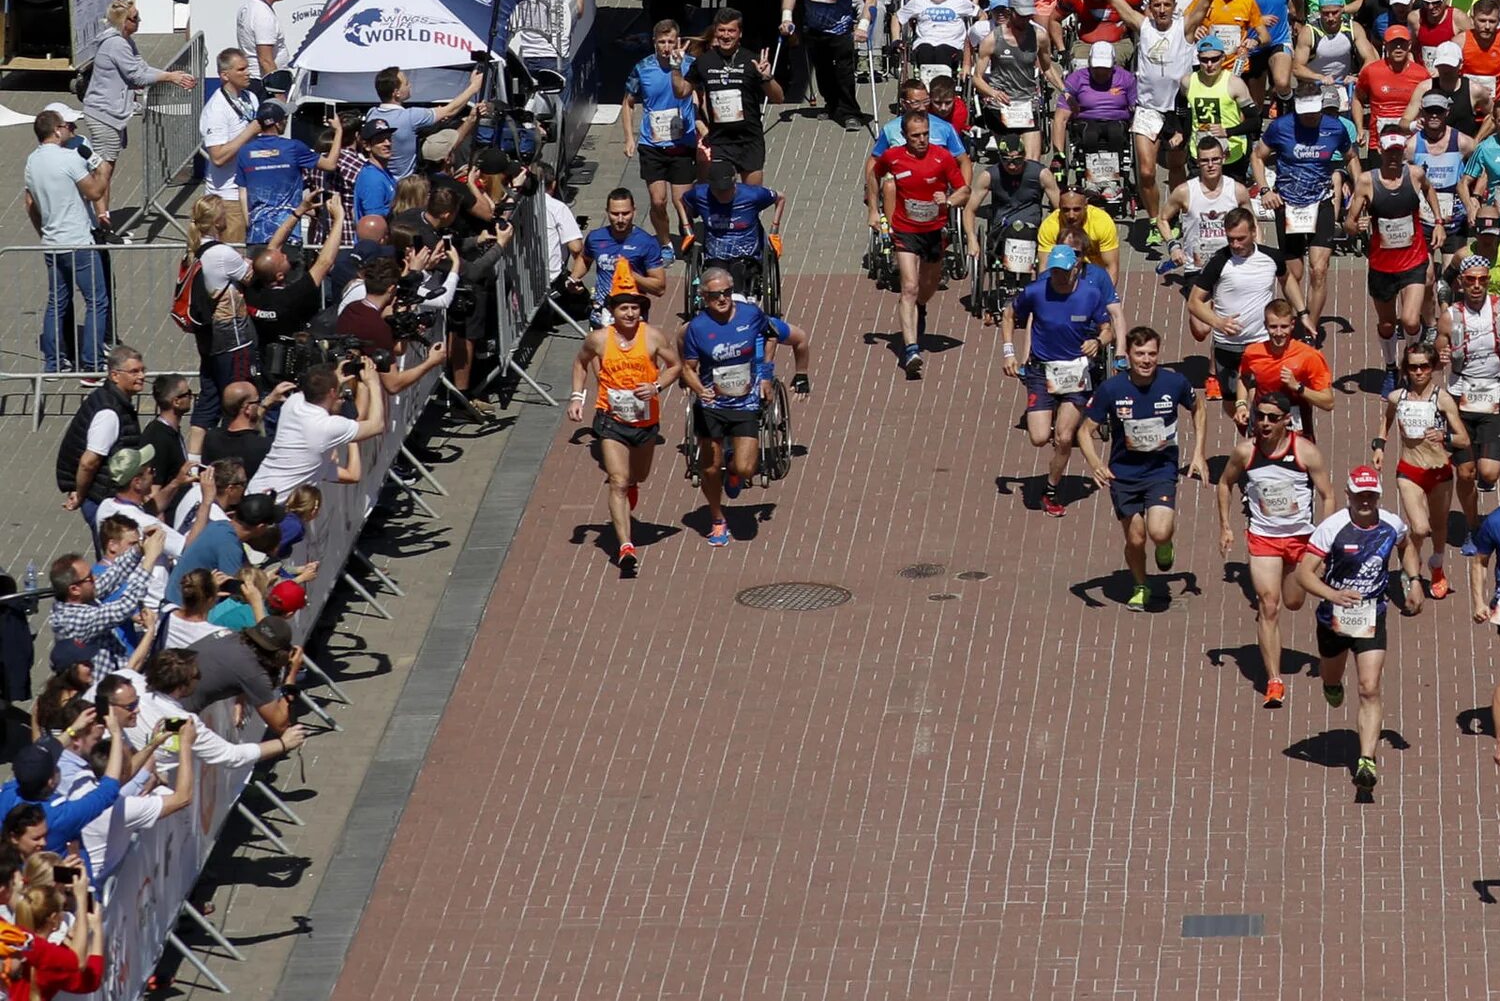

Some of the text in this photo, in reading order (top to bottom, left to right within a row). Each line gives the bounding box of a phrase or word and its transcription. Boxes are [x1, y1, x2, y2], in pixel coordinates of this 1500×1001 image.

[382, 14, 430, 26] WINGS
[365, 28, 473, 52] WORLD RUN
